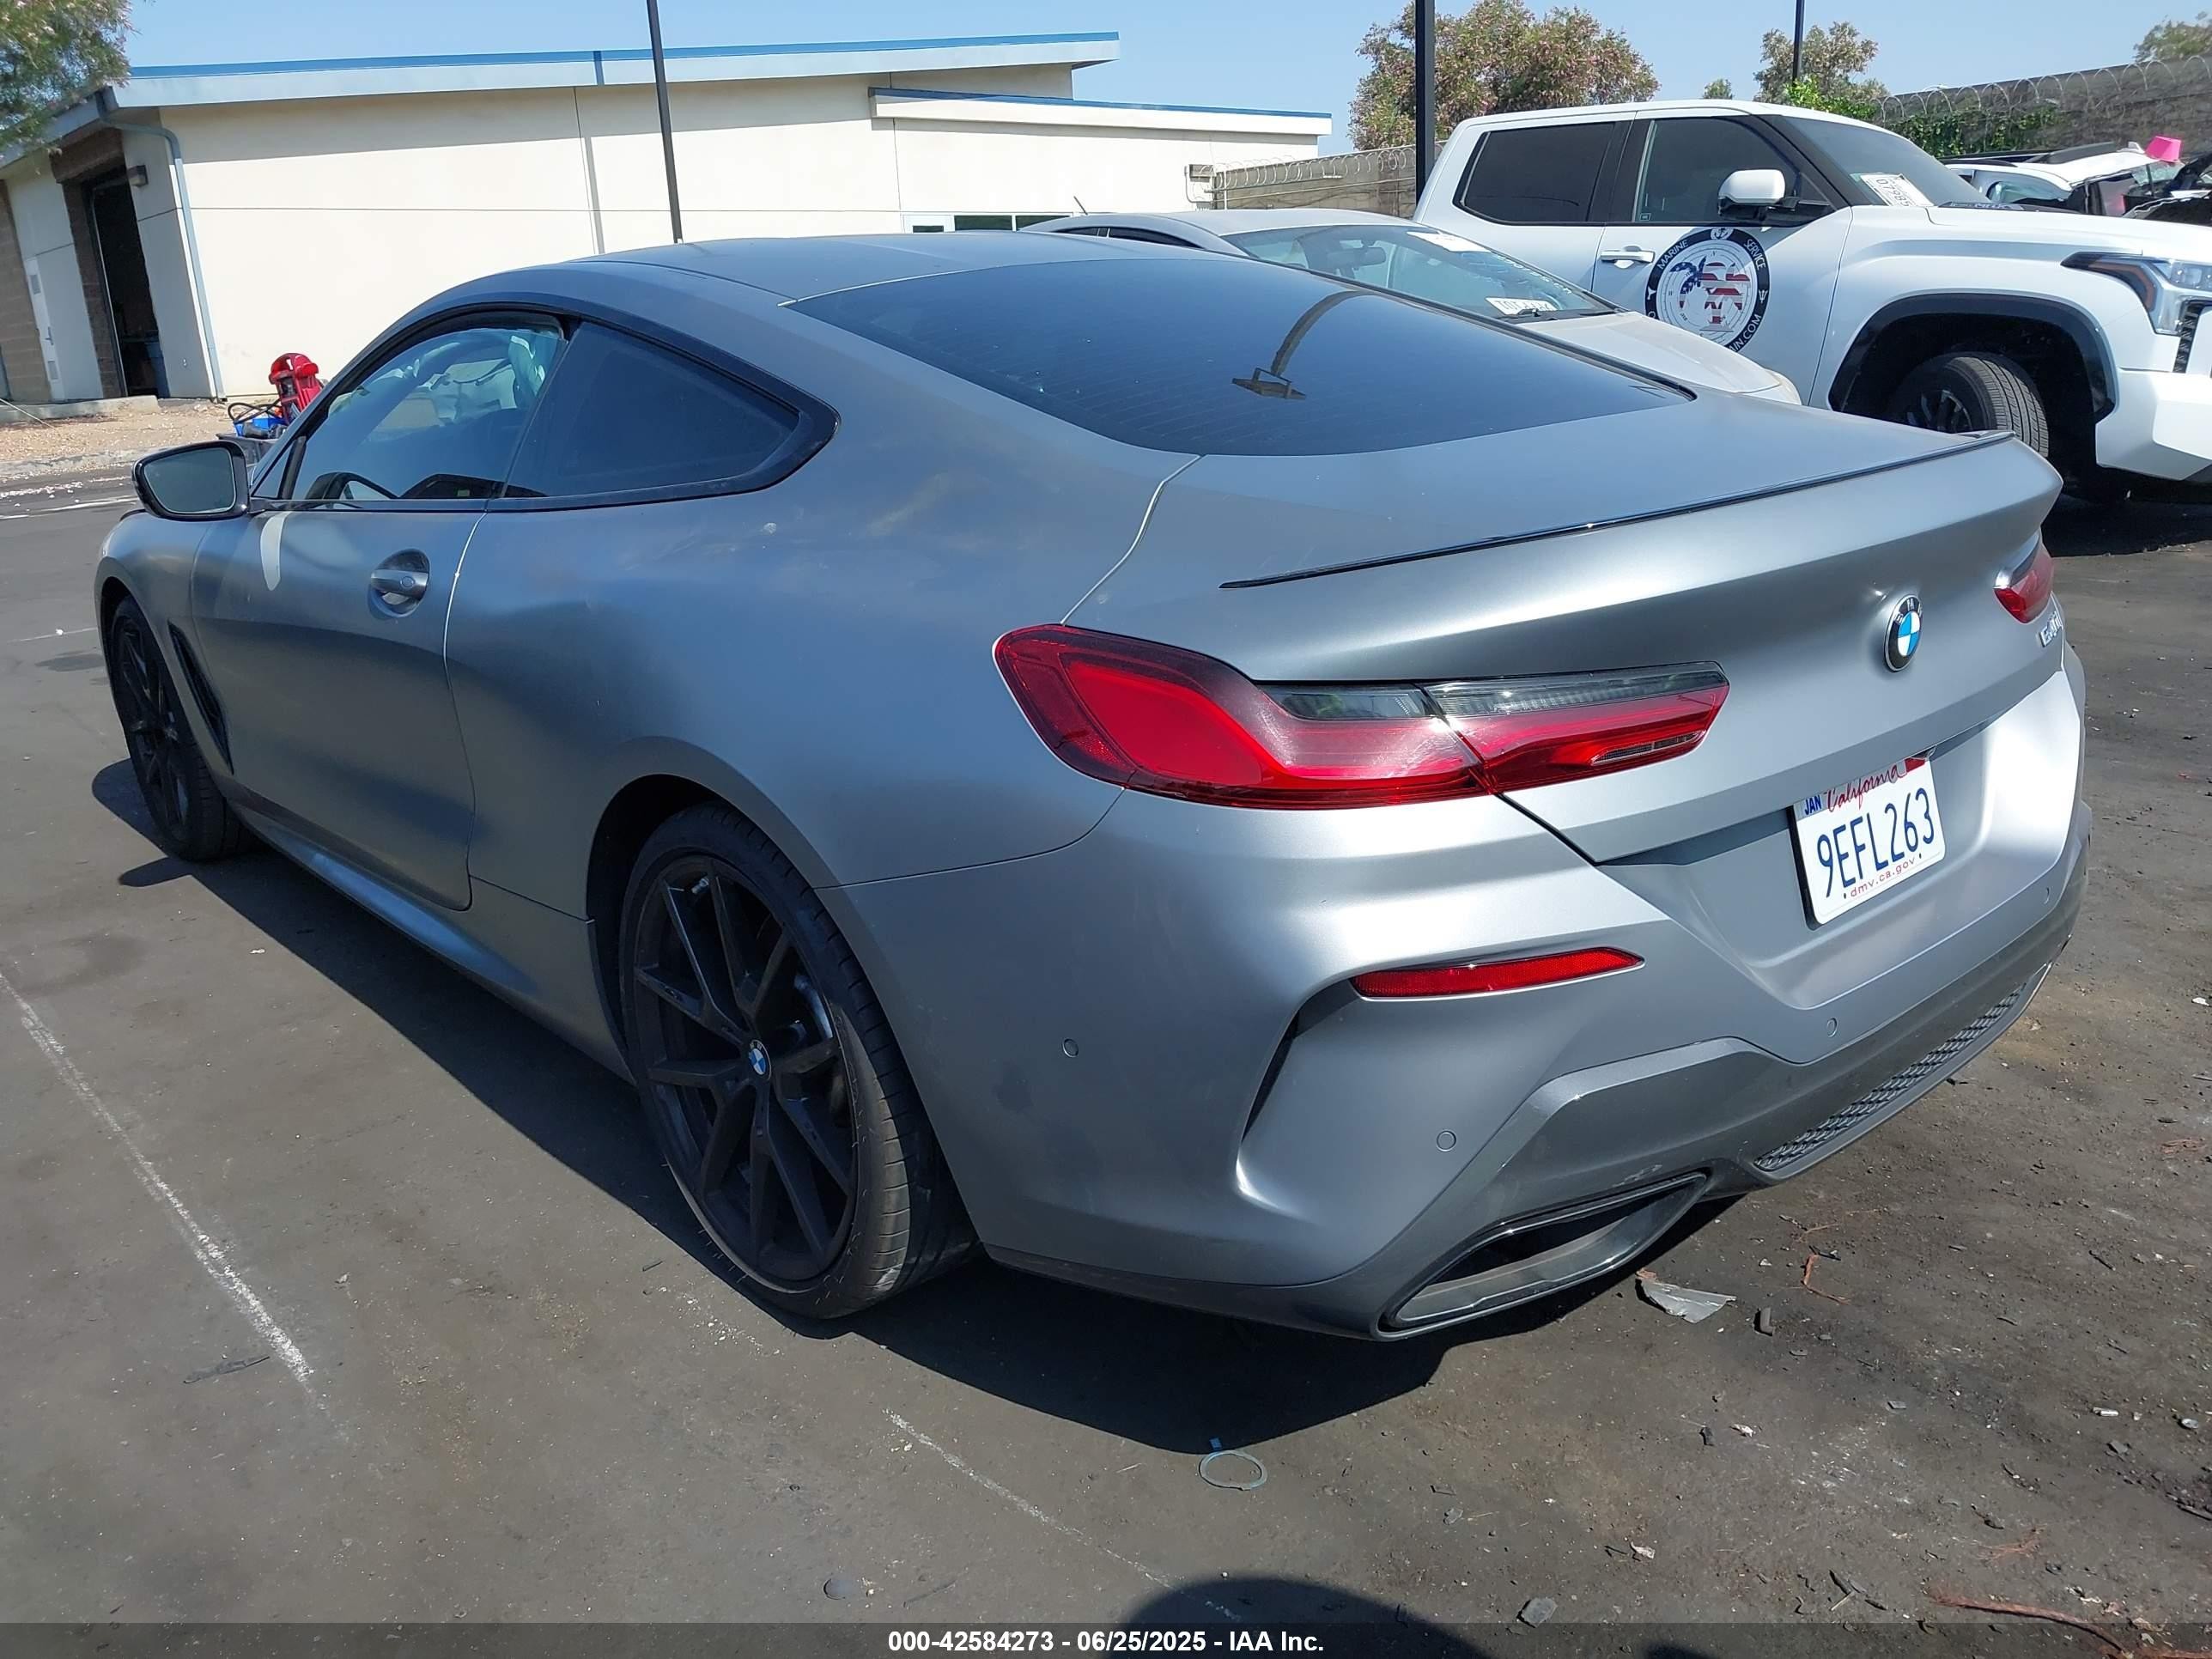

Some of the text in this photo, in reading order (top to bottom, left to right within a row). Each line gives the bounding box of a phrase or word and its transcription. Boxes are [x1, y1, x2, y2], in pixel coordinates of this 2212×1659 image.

[1657, 240, 1689, 270] MARINE
[1743, 239, 1766, 270] SERVICE
[1804, 794, 1822, 815] JAN
[1823, 763, 1906, 812] California
[1817, 787, 1935, 898] 9EFL263
[1850, 857, 1916, 898] dmv.ca.gov
